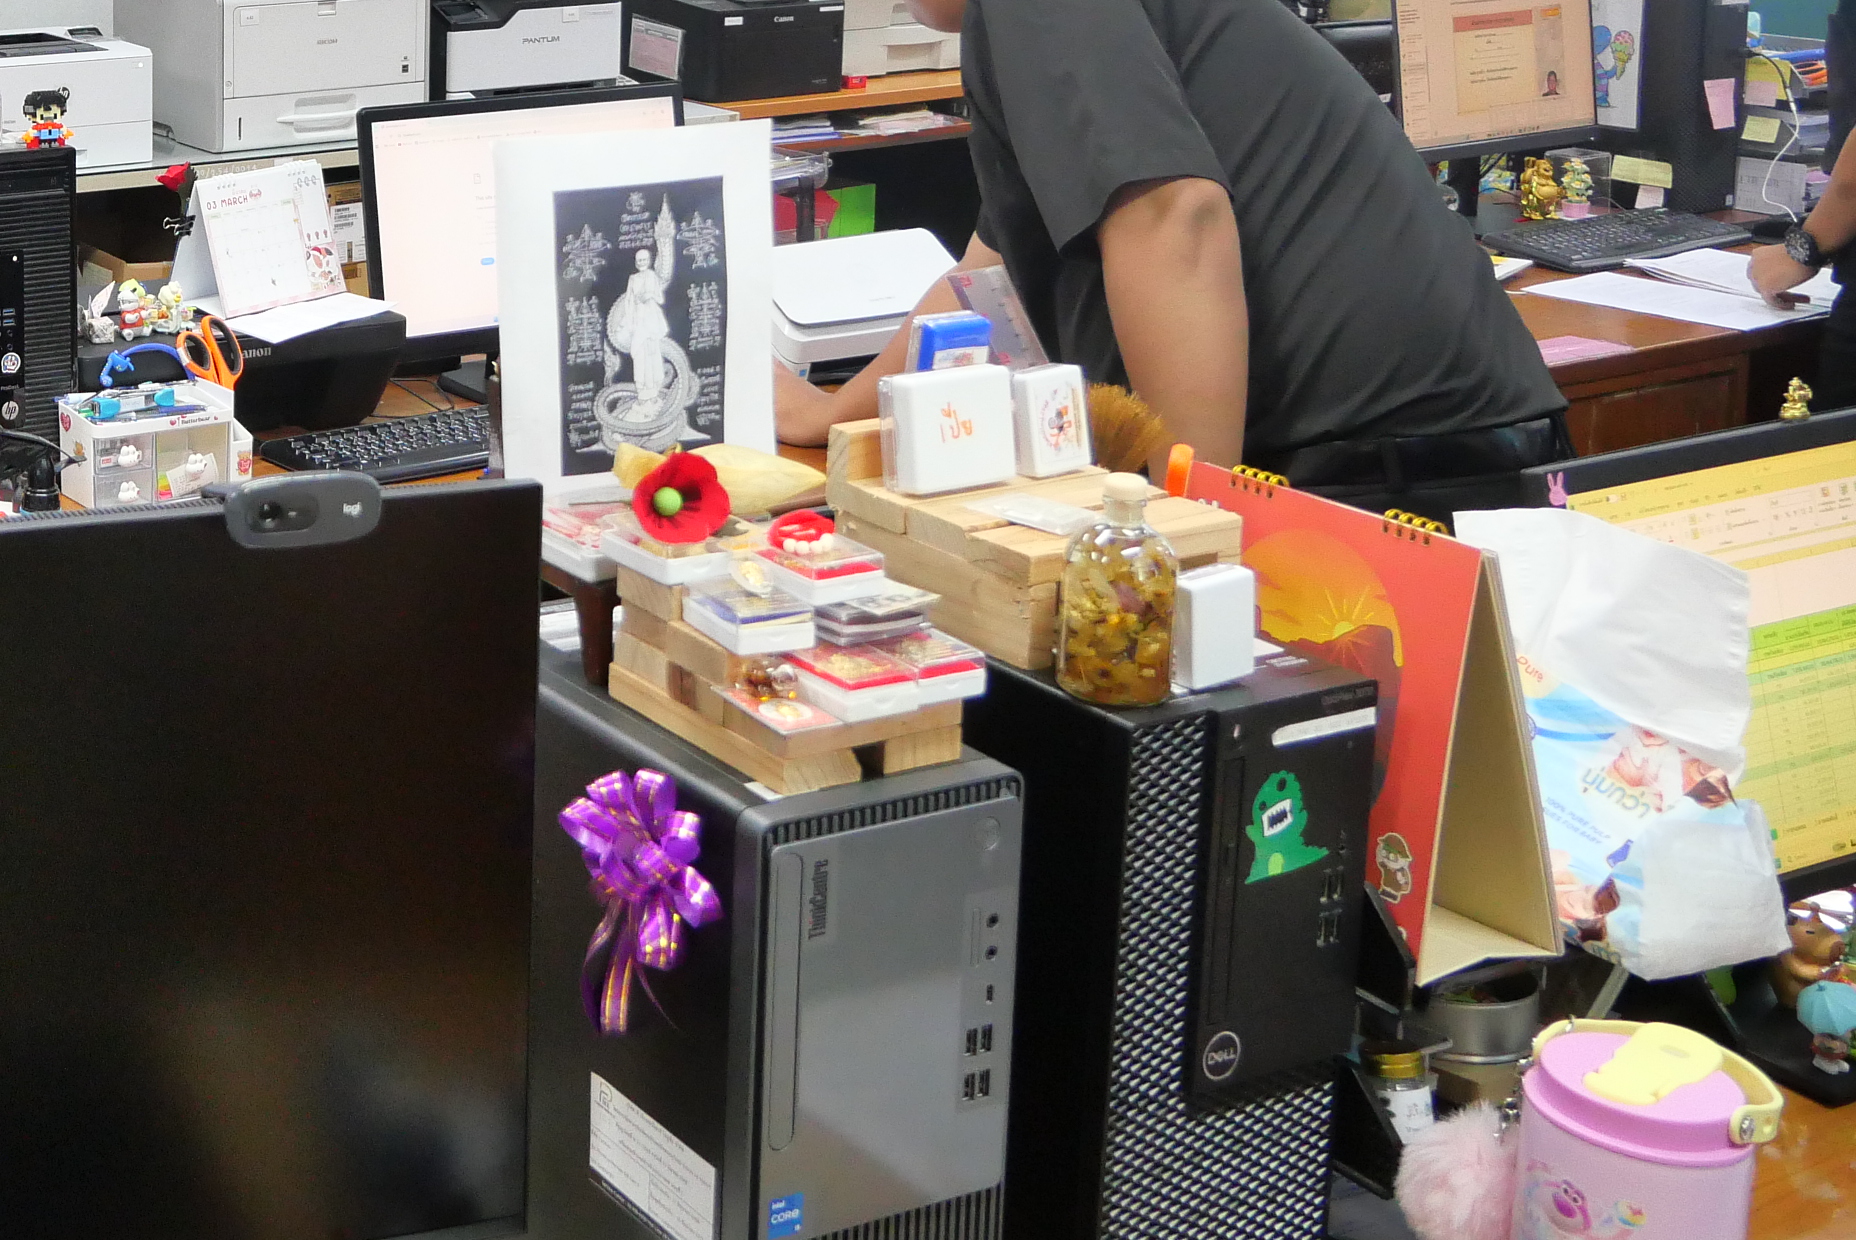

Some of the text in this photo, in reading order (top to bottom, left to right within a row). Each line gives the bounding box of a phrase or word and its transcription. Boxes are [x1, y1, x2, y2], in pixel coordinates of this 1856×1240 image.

[773, 15, 794, 23] Canon
[522, 36, 560, 44] PANTUM
[206, 195, 249, 211] 03 MARCH
[232, 347, 272, 359] anon
[2, 401, 19, 420] hp
[343, 502, 363, 518] logi
[1567, 810, 1588, 826] PURE
[808, 859, 829, 940] ThinkCentre
[1207, 1047, 1237, 1065] DELL
